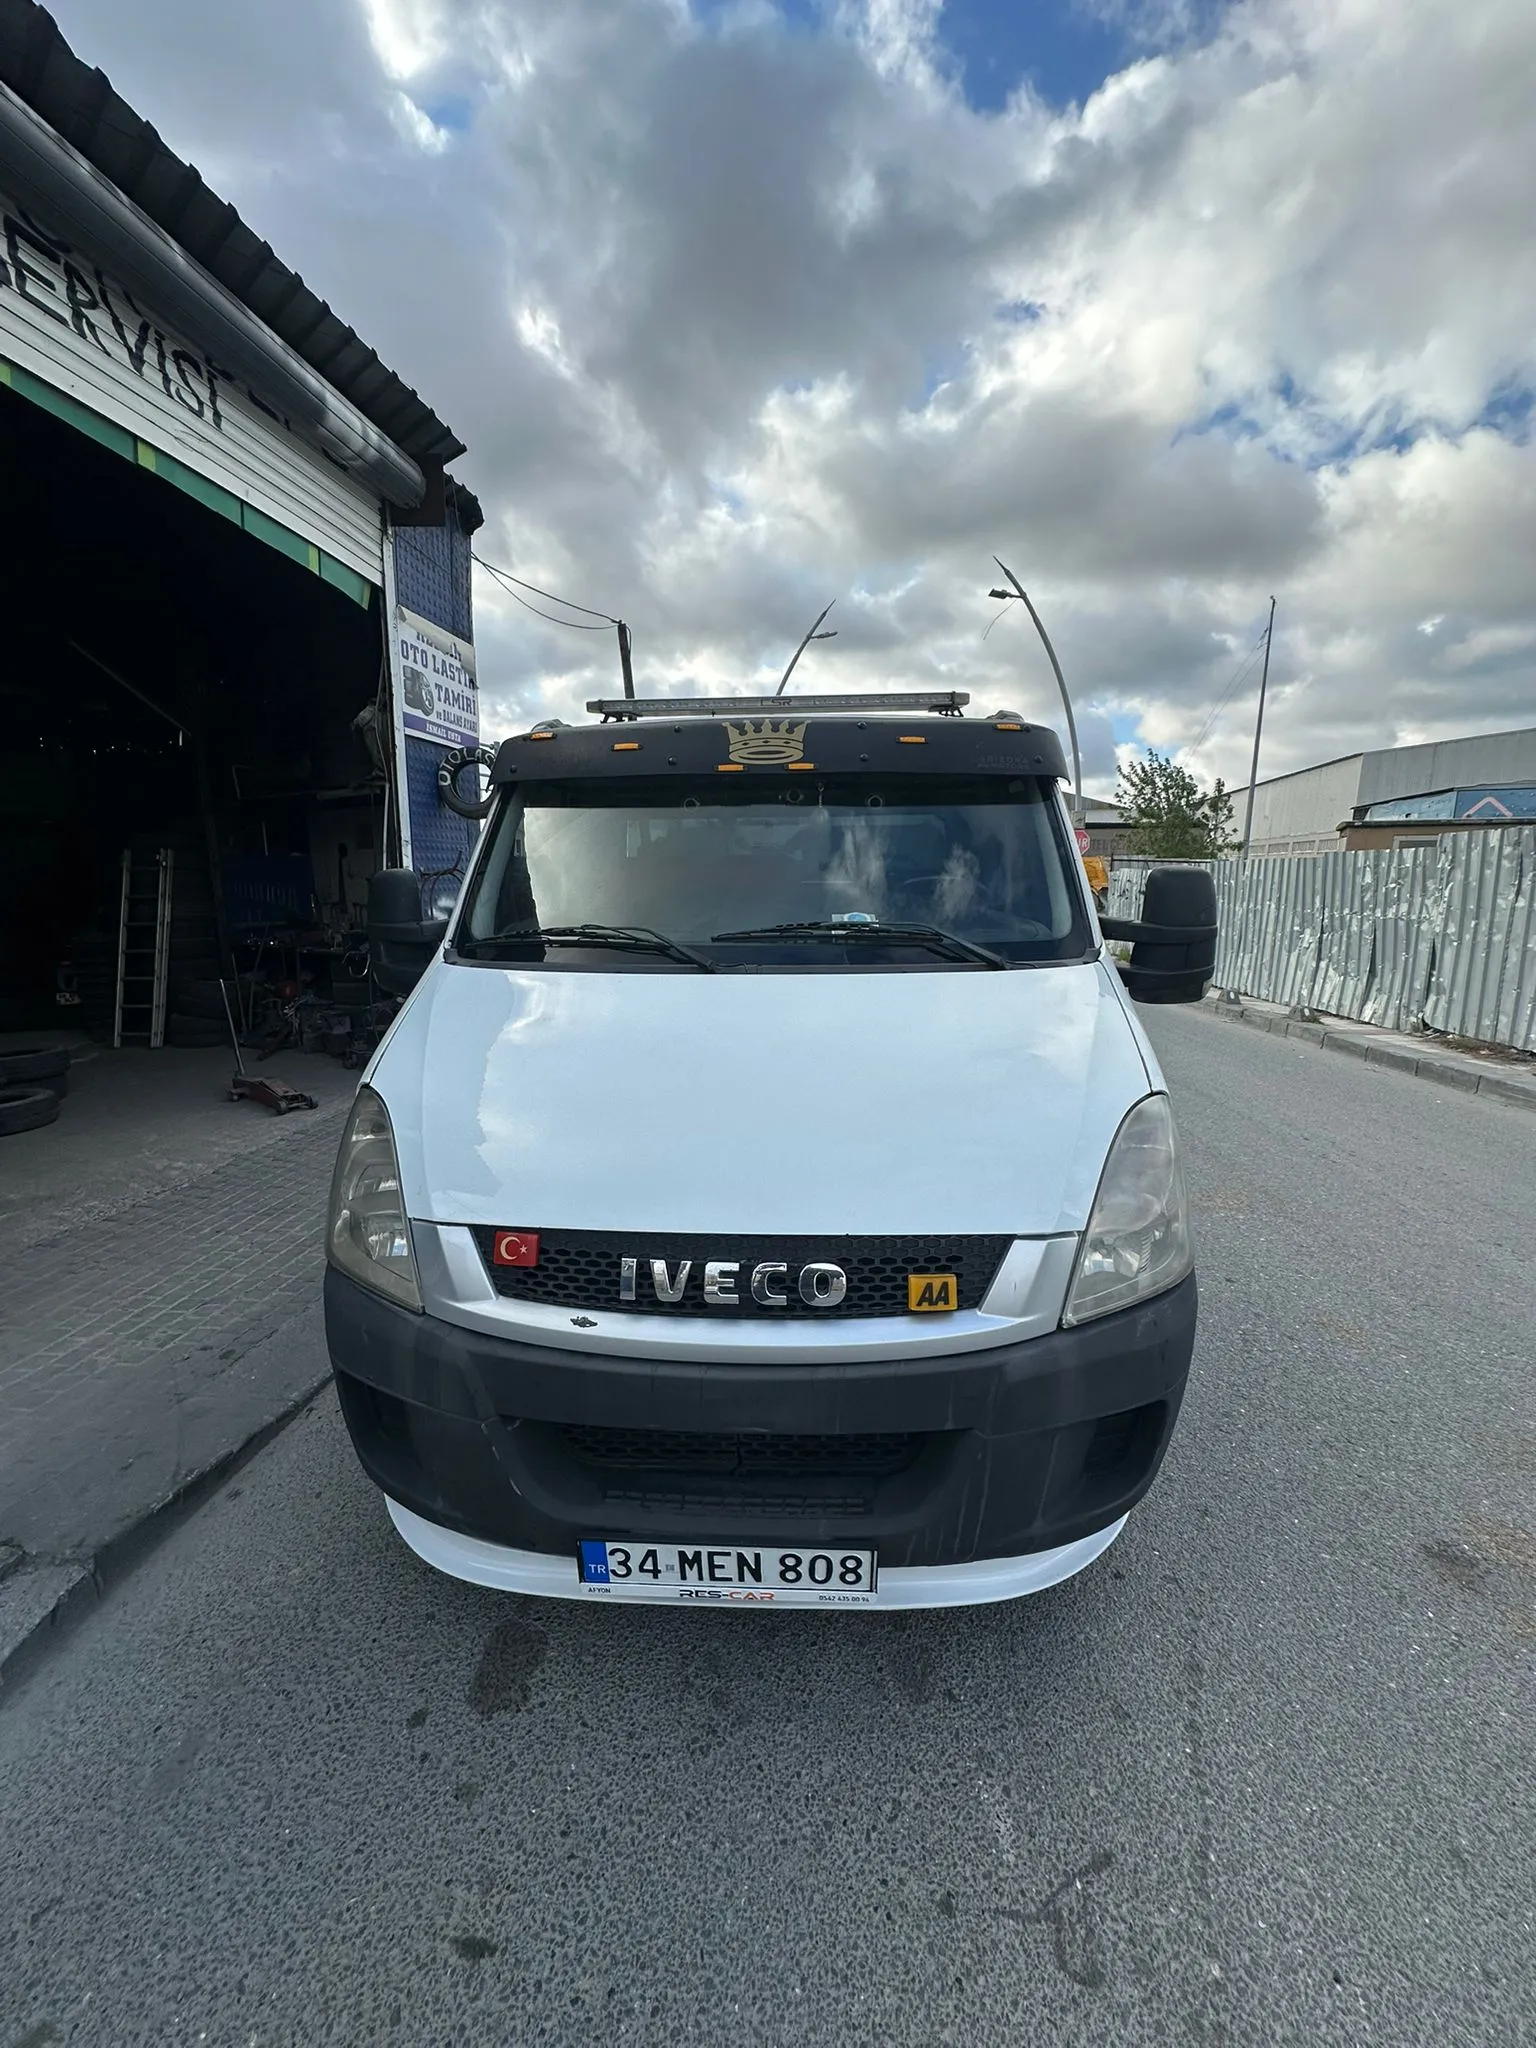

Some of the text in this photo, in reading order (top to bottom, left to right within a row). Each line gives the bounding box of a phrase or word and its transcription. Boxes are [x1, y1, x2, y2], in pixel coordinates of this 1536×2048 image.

[400, 639, 428, 669] OTO
[434, 682, 477, 716] TAMİRİ
[619, 1257, 847, 1307] IVECO
[916, 1281, 950, 1306] AA
[588, 1547, 863, 1586] TR 34 MEN 808
[679, 1589, 776, 1601] RES-CAR
